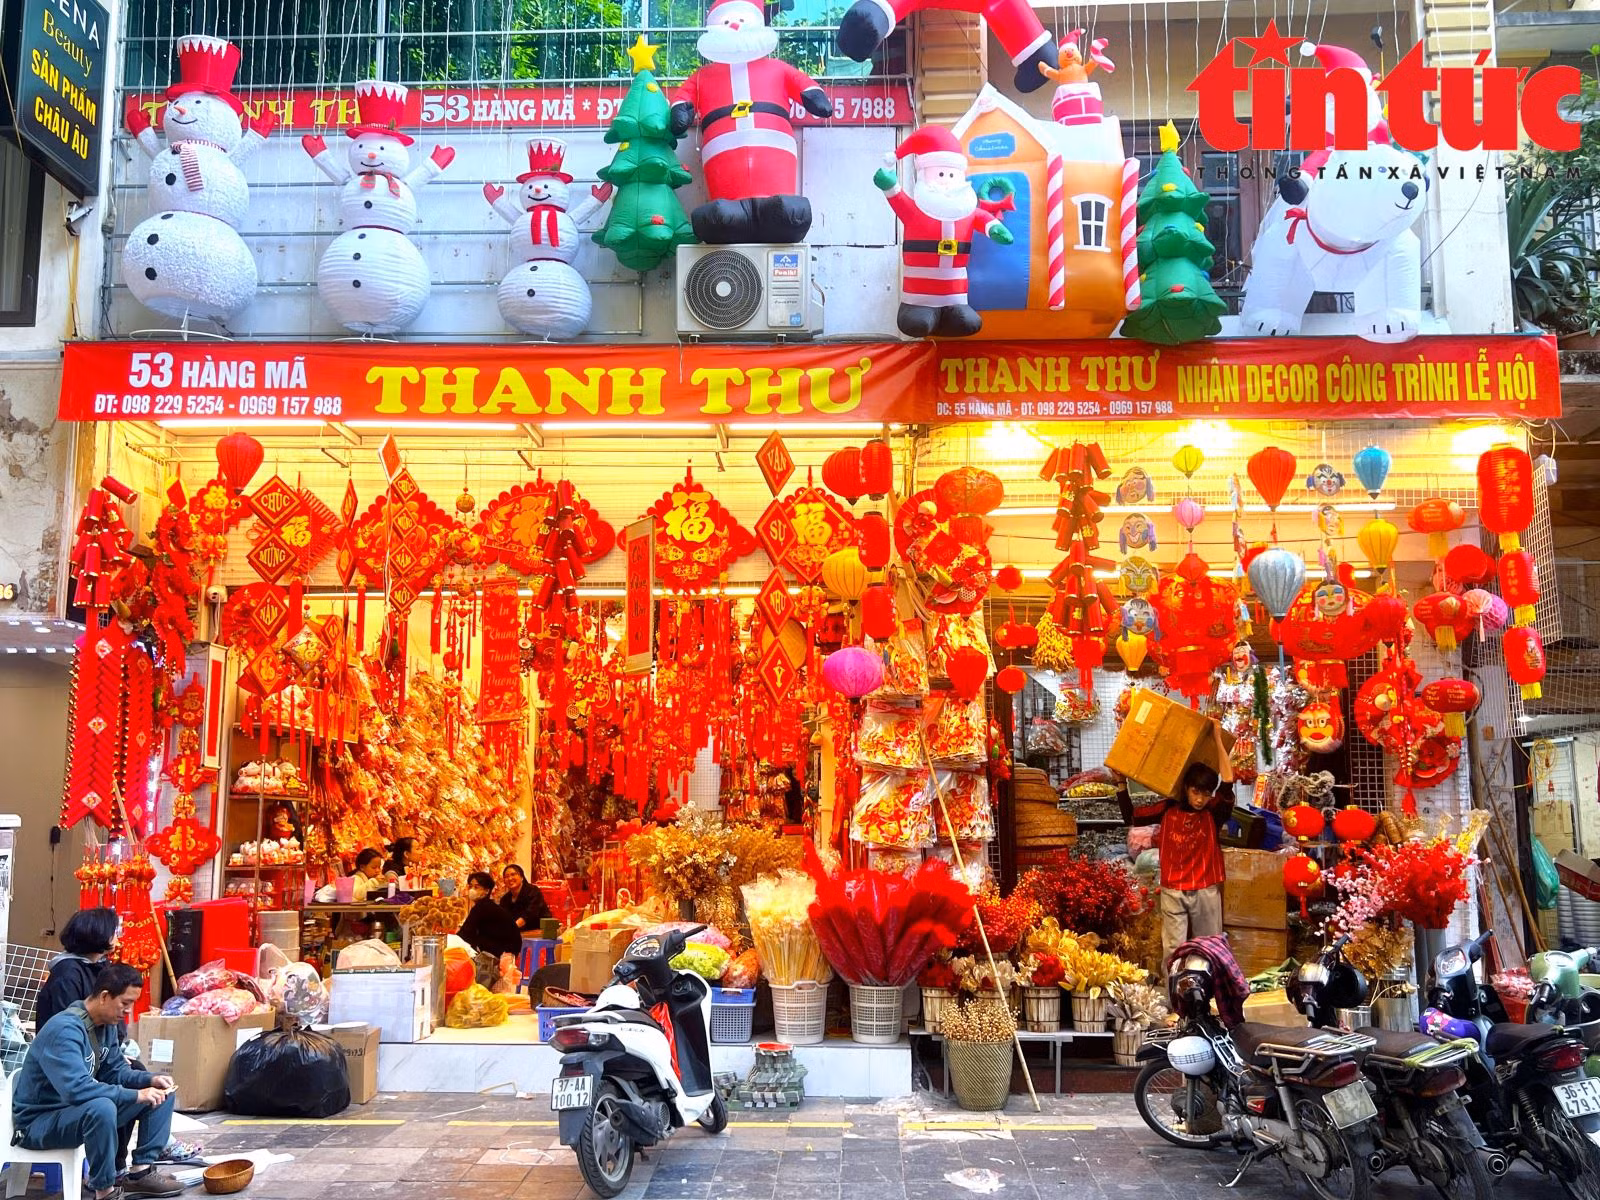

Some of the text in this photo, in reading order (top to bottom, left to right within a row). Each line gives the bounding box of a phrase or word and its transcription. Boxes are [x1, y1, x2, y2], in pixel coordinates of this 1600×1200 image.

[42, 8, 93, 78] Beauty
[31, 48, 97, 126] SẢN PHẨM
[420, 94, 470, 122] 53
[472, 93, 537, 121] HÀNG
[542, 94, 576, 121] MÃ
[851, 97, 896, 119] 7988
[34, 96, 89, 160] CHÂU ÂU
[128, 352, 308, 389] 53 HÀNG MÃ
[940, 348, 1161, 393] THANH THƯ
[1177, 347, 1537, 412] NHẬN DECOR CÔNG TRÌNH LỄ HỘI
[365, 356, 873, 416] THANH THƯ
[94, 394, 118, 414] ĐT:
[121, 394, 150, 414] 098
[154, 394, 183, 414] 229
[186, 395, 224, 415] 5254
[239, 396, 276, 415] 0969
[281, 396, 307, 415] 157
[313, 396, 343, 415] 988
[954, 401, 966, 416] 55
[968, 398, 994, 416] HÀNG
[996, 399, 1013, 416] MÃ
[1021, 401, 1035, 416] ĐT:
[1037, 401, 1054, 415] 098
[1057, 401, 1075, 415] 229
[1077, 401, 1100, 415] 5254
[1109, 400, 1133, 415] 0969
[1136, 400, 1152, 414] 157
[1155, 400, 1173, 414] 988
[260, 488, 291, 513] CHÚC
[663, 491, 716, 543] 福
[258, 541, 287, 568] MỪNG
[558, 1077, 586, 1093] 37-AA
[1560, 1080, 1598, 1100] 36-F1
[554, 1092, 589, 1108] 100.12
[1565, 1093, 1600, 1115] 479.1
